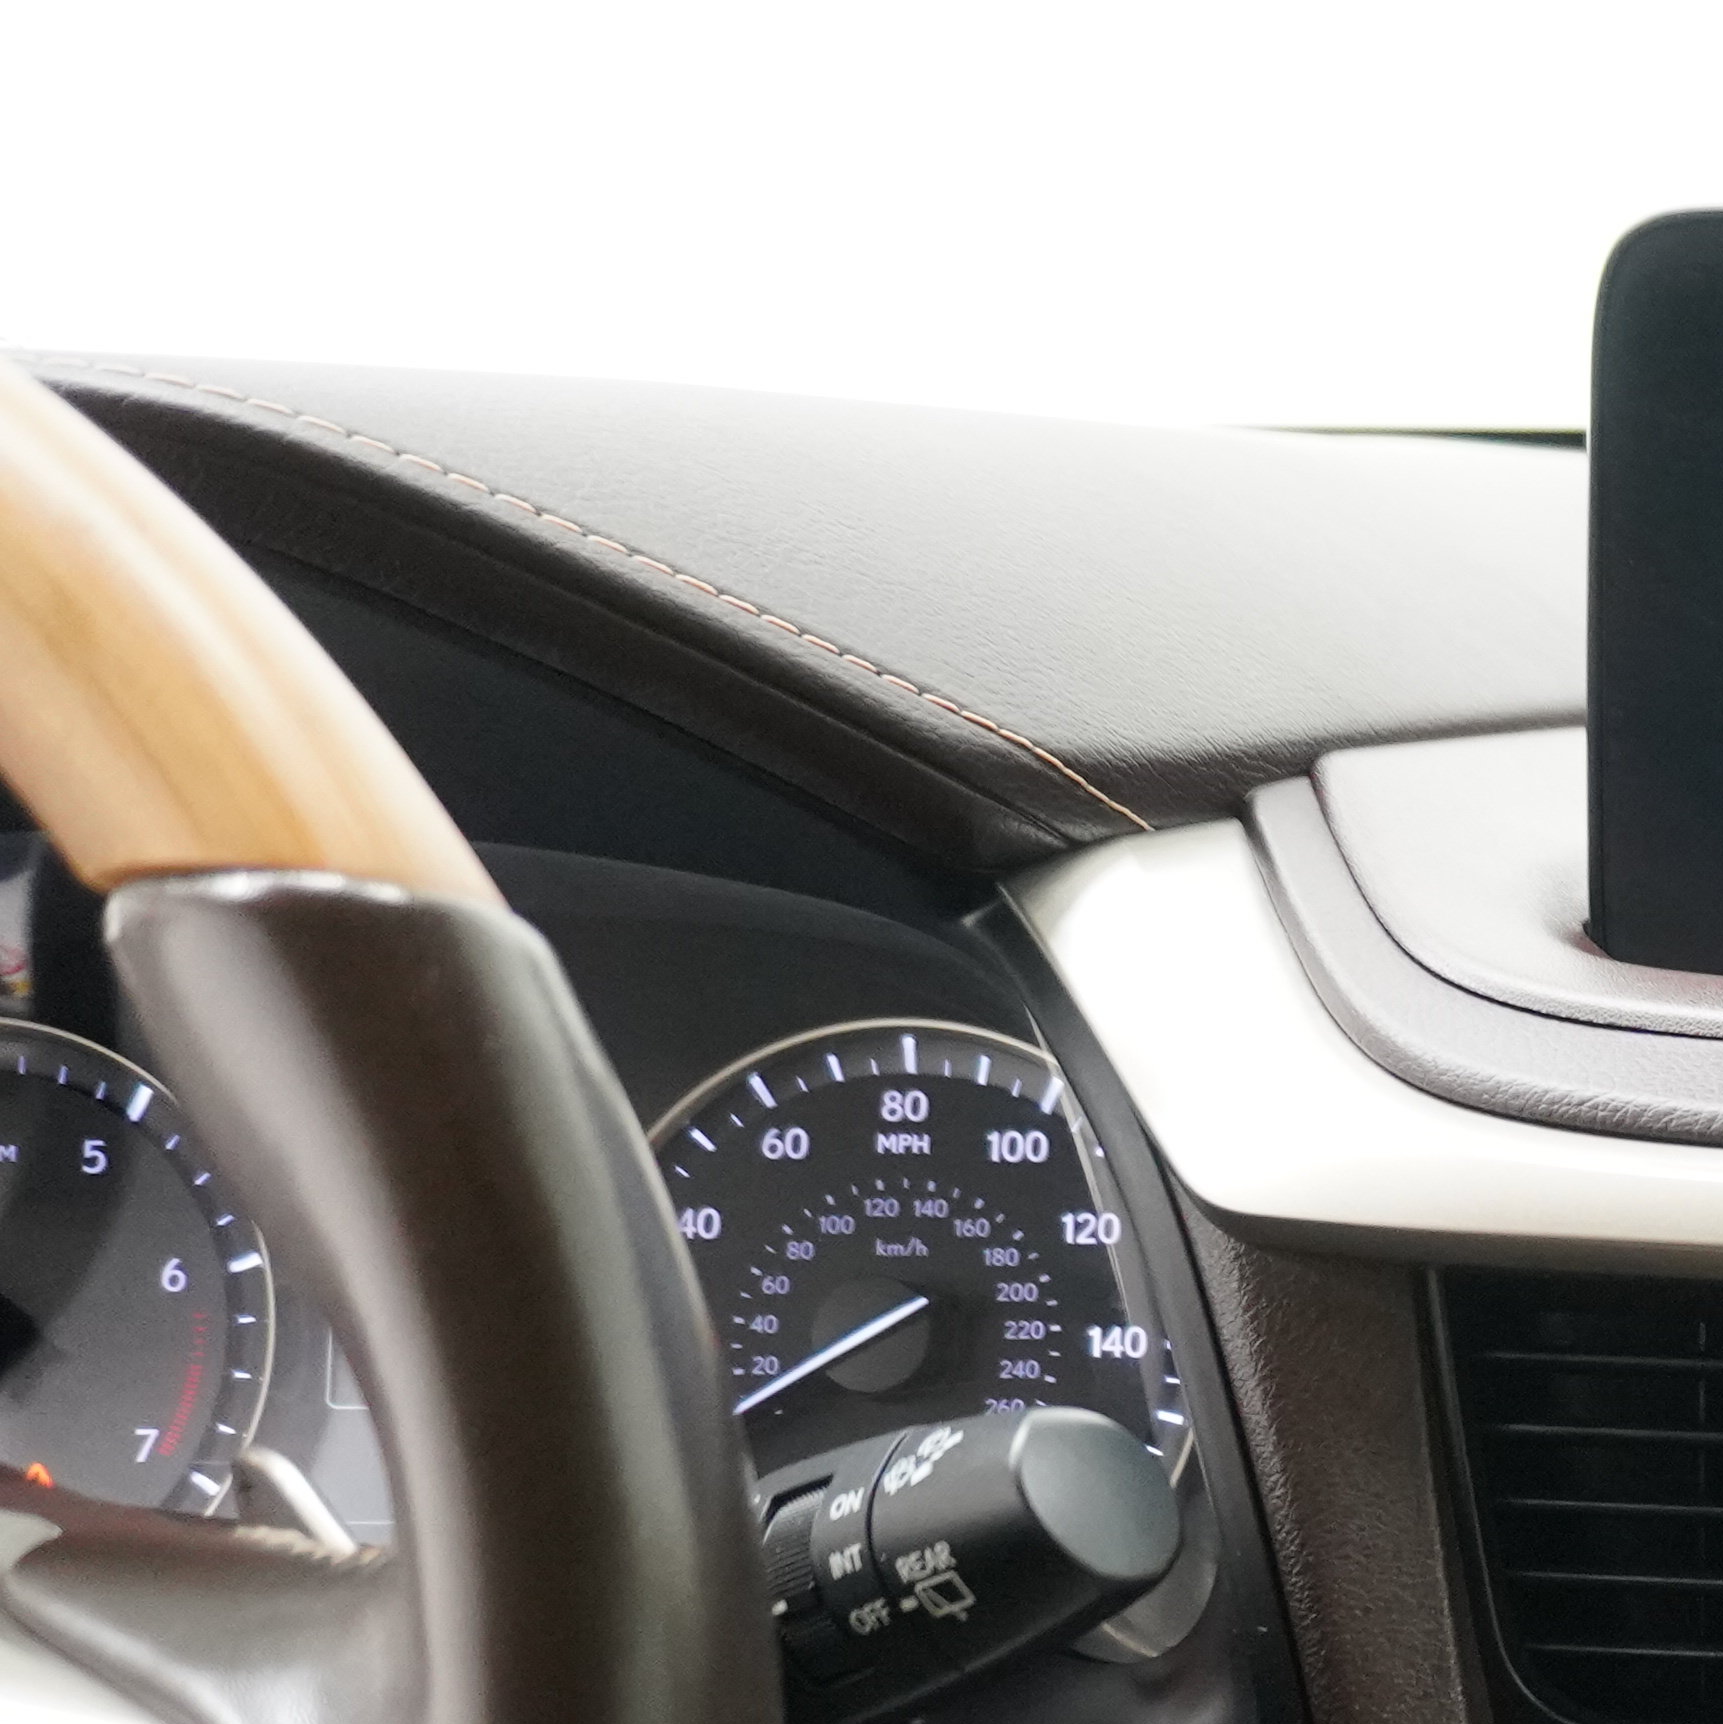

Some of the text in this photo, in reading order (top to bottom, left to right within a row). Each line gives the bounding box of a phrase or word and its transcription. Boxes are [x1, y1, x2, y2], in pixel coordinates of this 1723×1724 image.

[880, 1089, 930, 1123] 80
[761, 1126, 810, 1161] 60
[876, 1132, 932, 1155] MPH
[986, 1129, 1051, 1164] 100
[81, 1138, 109, 1175] 5
[863, 1197, 900, 1218] 120
[913, 1197, 949, 1218] 140
[679, 1205, 722, 1240] 40
[819, 1214, 856, 1235] 100
[954, 1217, 991, 1238] 160
[1060, 1211, 1122, 1245] 120
[784, 1239, 815, 1261] 80
[874, 1236, 930, 1258] km/h
[984, 1247, 1020, 1267] 180
[160, 1256, 188, 1293] 6
[761, 1274, 790, 1295] 60
[997, 1282, 1039, 1302] 200
[749, 1313, 780, 1334] 40
[1003, 1319, 1046, 1340] 220
[1086, 1324, 1148, 1359] 140
[750, 1354, 780, 1377] 20
[999, 1359, 1041, 1380] 240
[133, 1426, 161, 1464] 7
[829, 1486, 865, 1522] ON
[828, 1542, 864, 1582] INT
[894, 1539, 958, 1584] REAR
[849, 1596, 892, 1636] OFF
